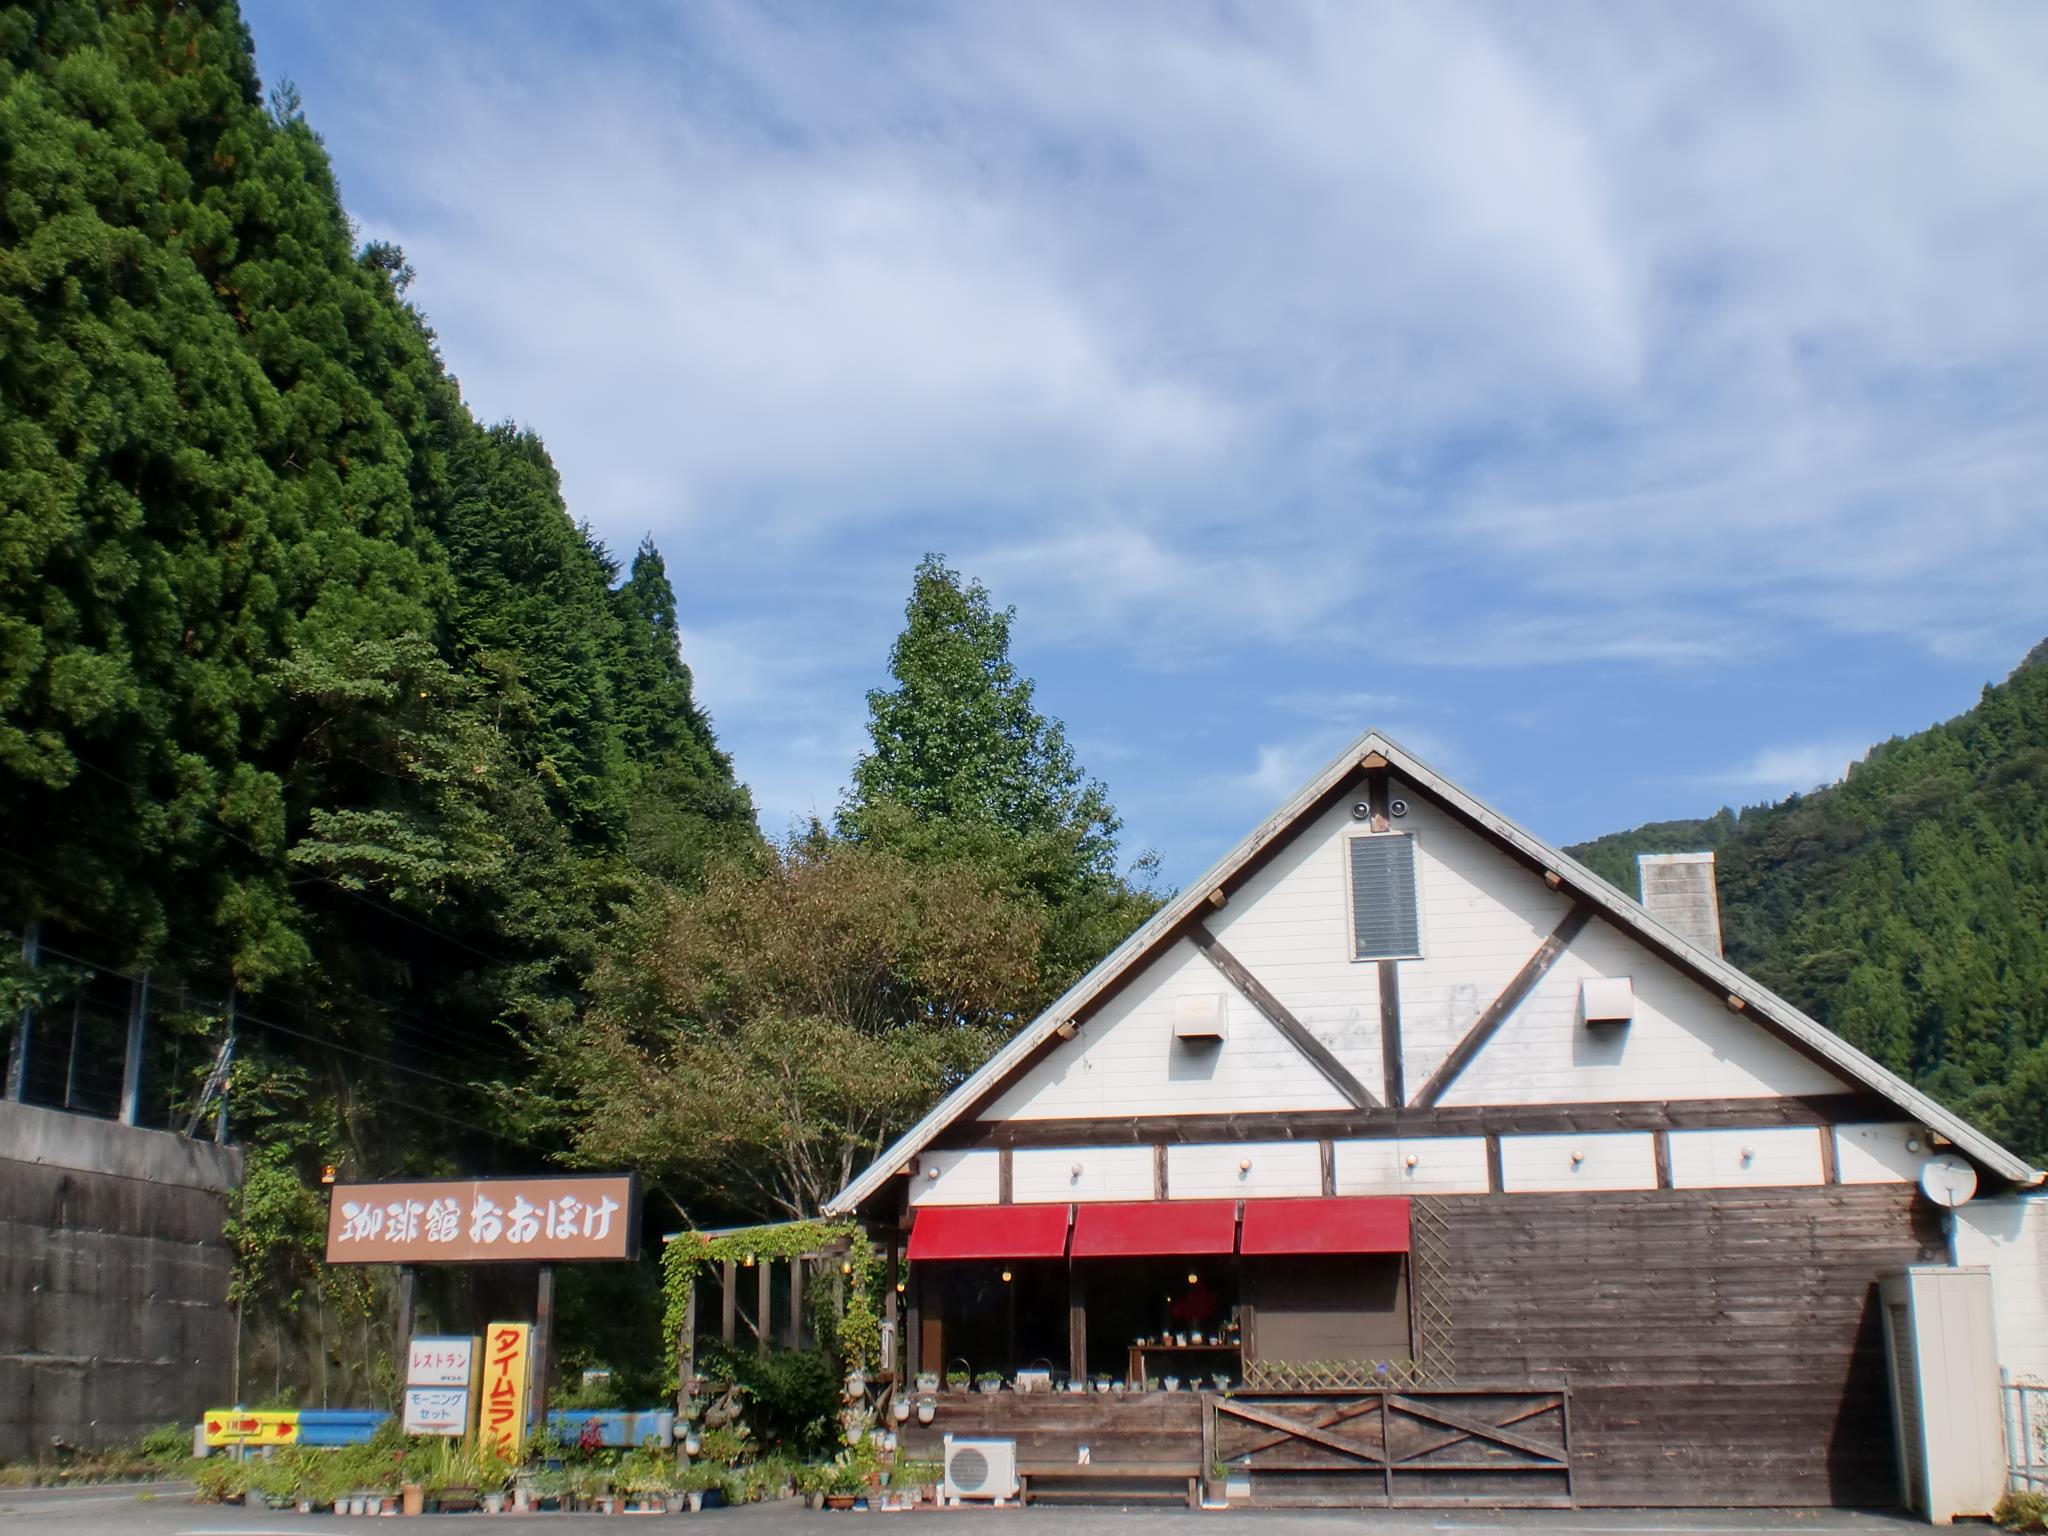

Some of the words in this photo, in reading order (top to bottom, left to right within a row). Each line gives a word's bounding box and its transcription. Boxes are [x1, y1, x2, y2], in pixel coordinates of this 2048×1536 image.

[338, 1194, 620, 1244] 珈琲館おおぼけ
[413, 1352, 467, 1369] レストラン
[411, 1393, 463, 1406] モーニング
[419, 1408, 451, 1419] セット
